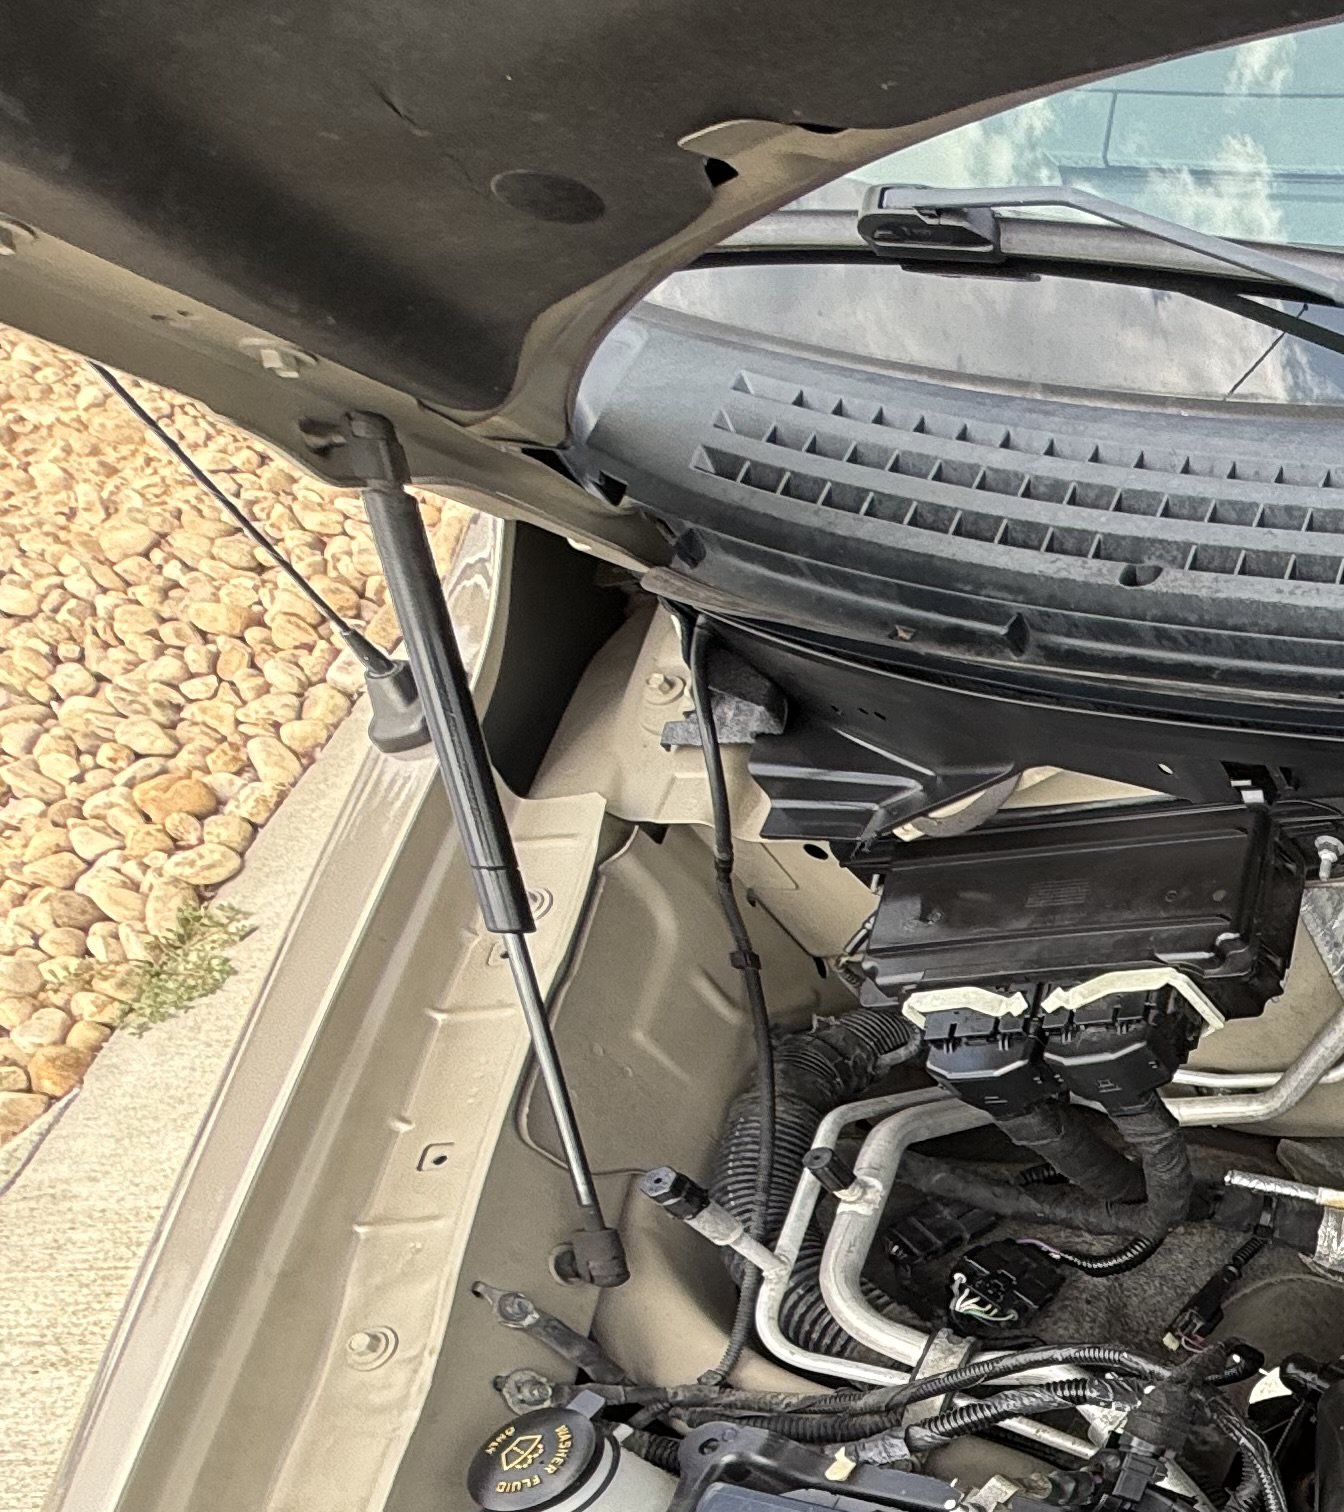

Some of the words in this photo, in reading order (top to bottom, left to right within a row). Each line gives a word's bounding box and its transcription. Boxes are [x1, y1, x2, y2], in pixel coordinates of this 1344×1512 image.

[484, 1426, 516, 1456] ONLY
[542, 1424, 573, 1475] WASHER
[494, 1474, 543, 1494] FLUID
